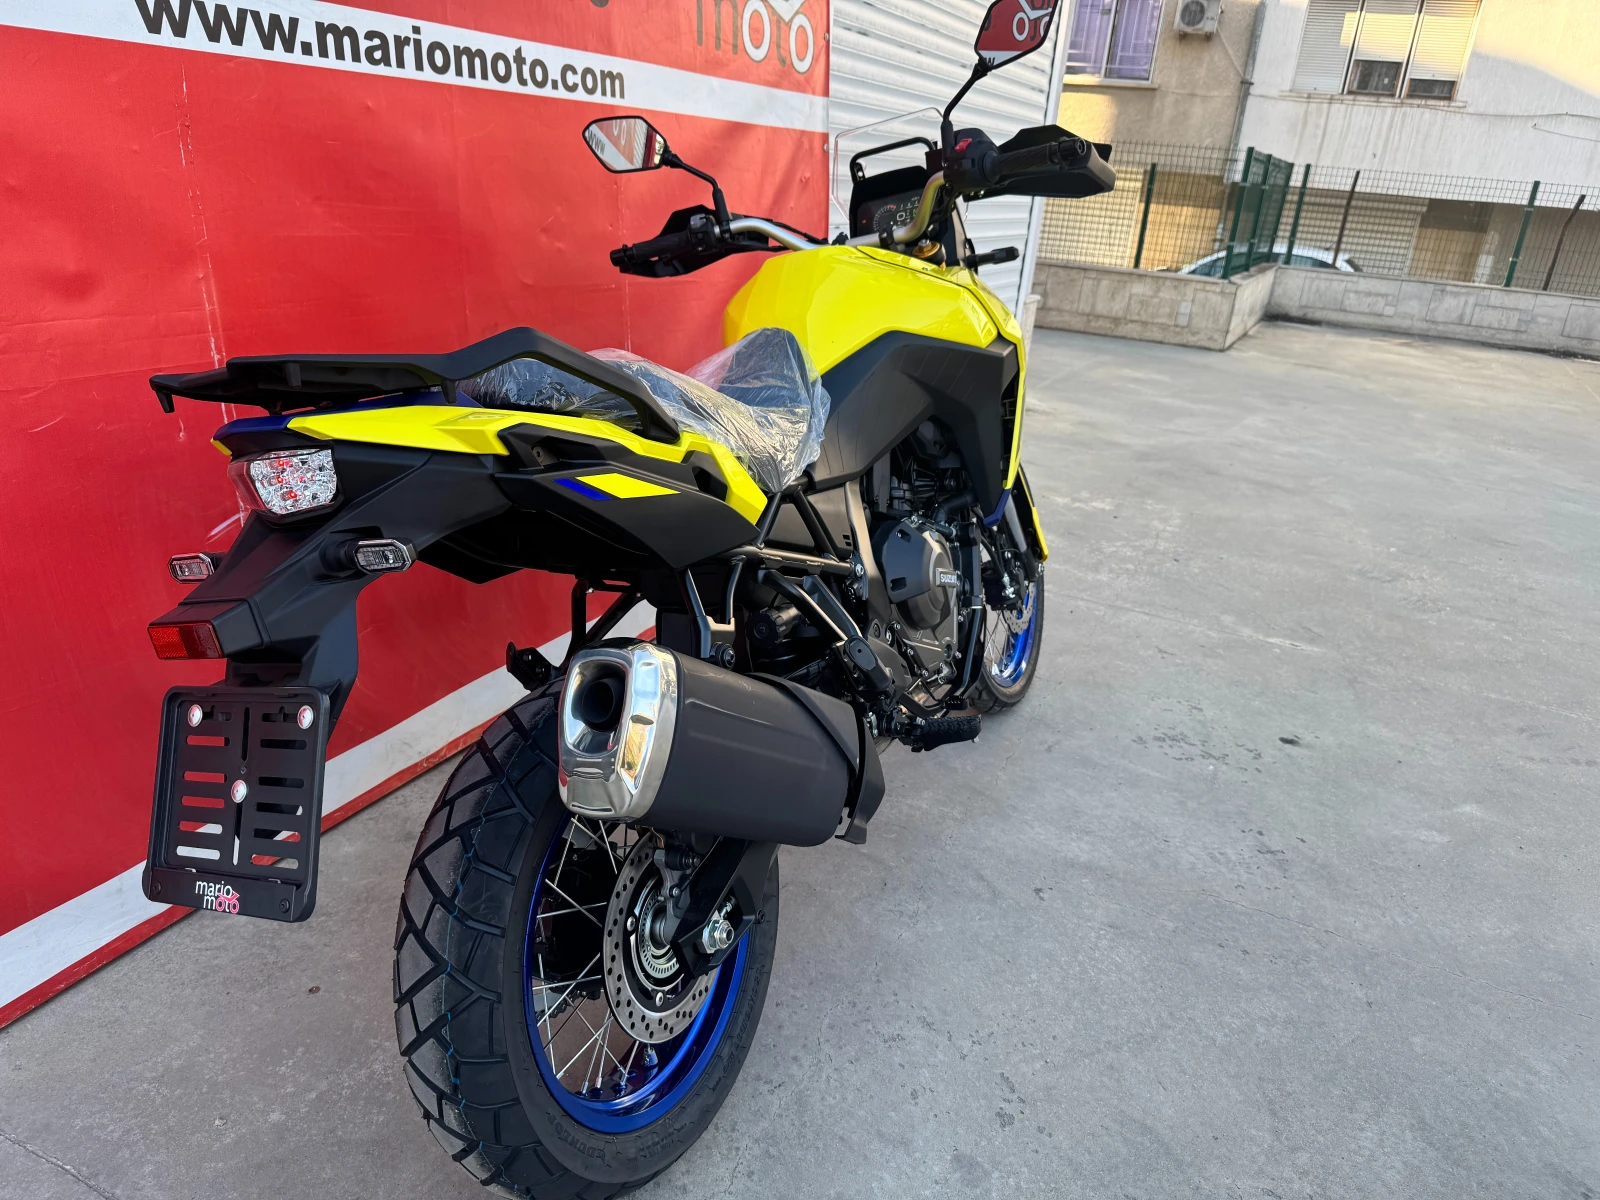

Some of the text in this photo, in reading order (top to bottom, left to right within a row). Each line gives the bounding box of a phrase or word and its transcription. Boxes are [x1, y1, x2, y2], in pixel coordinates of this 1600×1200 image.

[135, 0, 626, 99] www.mariomoto.com
[195, 881, 233, 898] mario
[203, 895, 240, 914] moto
